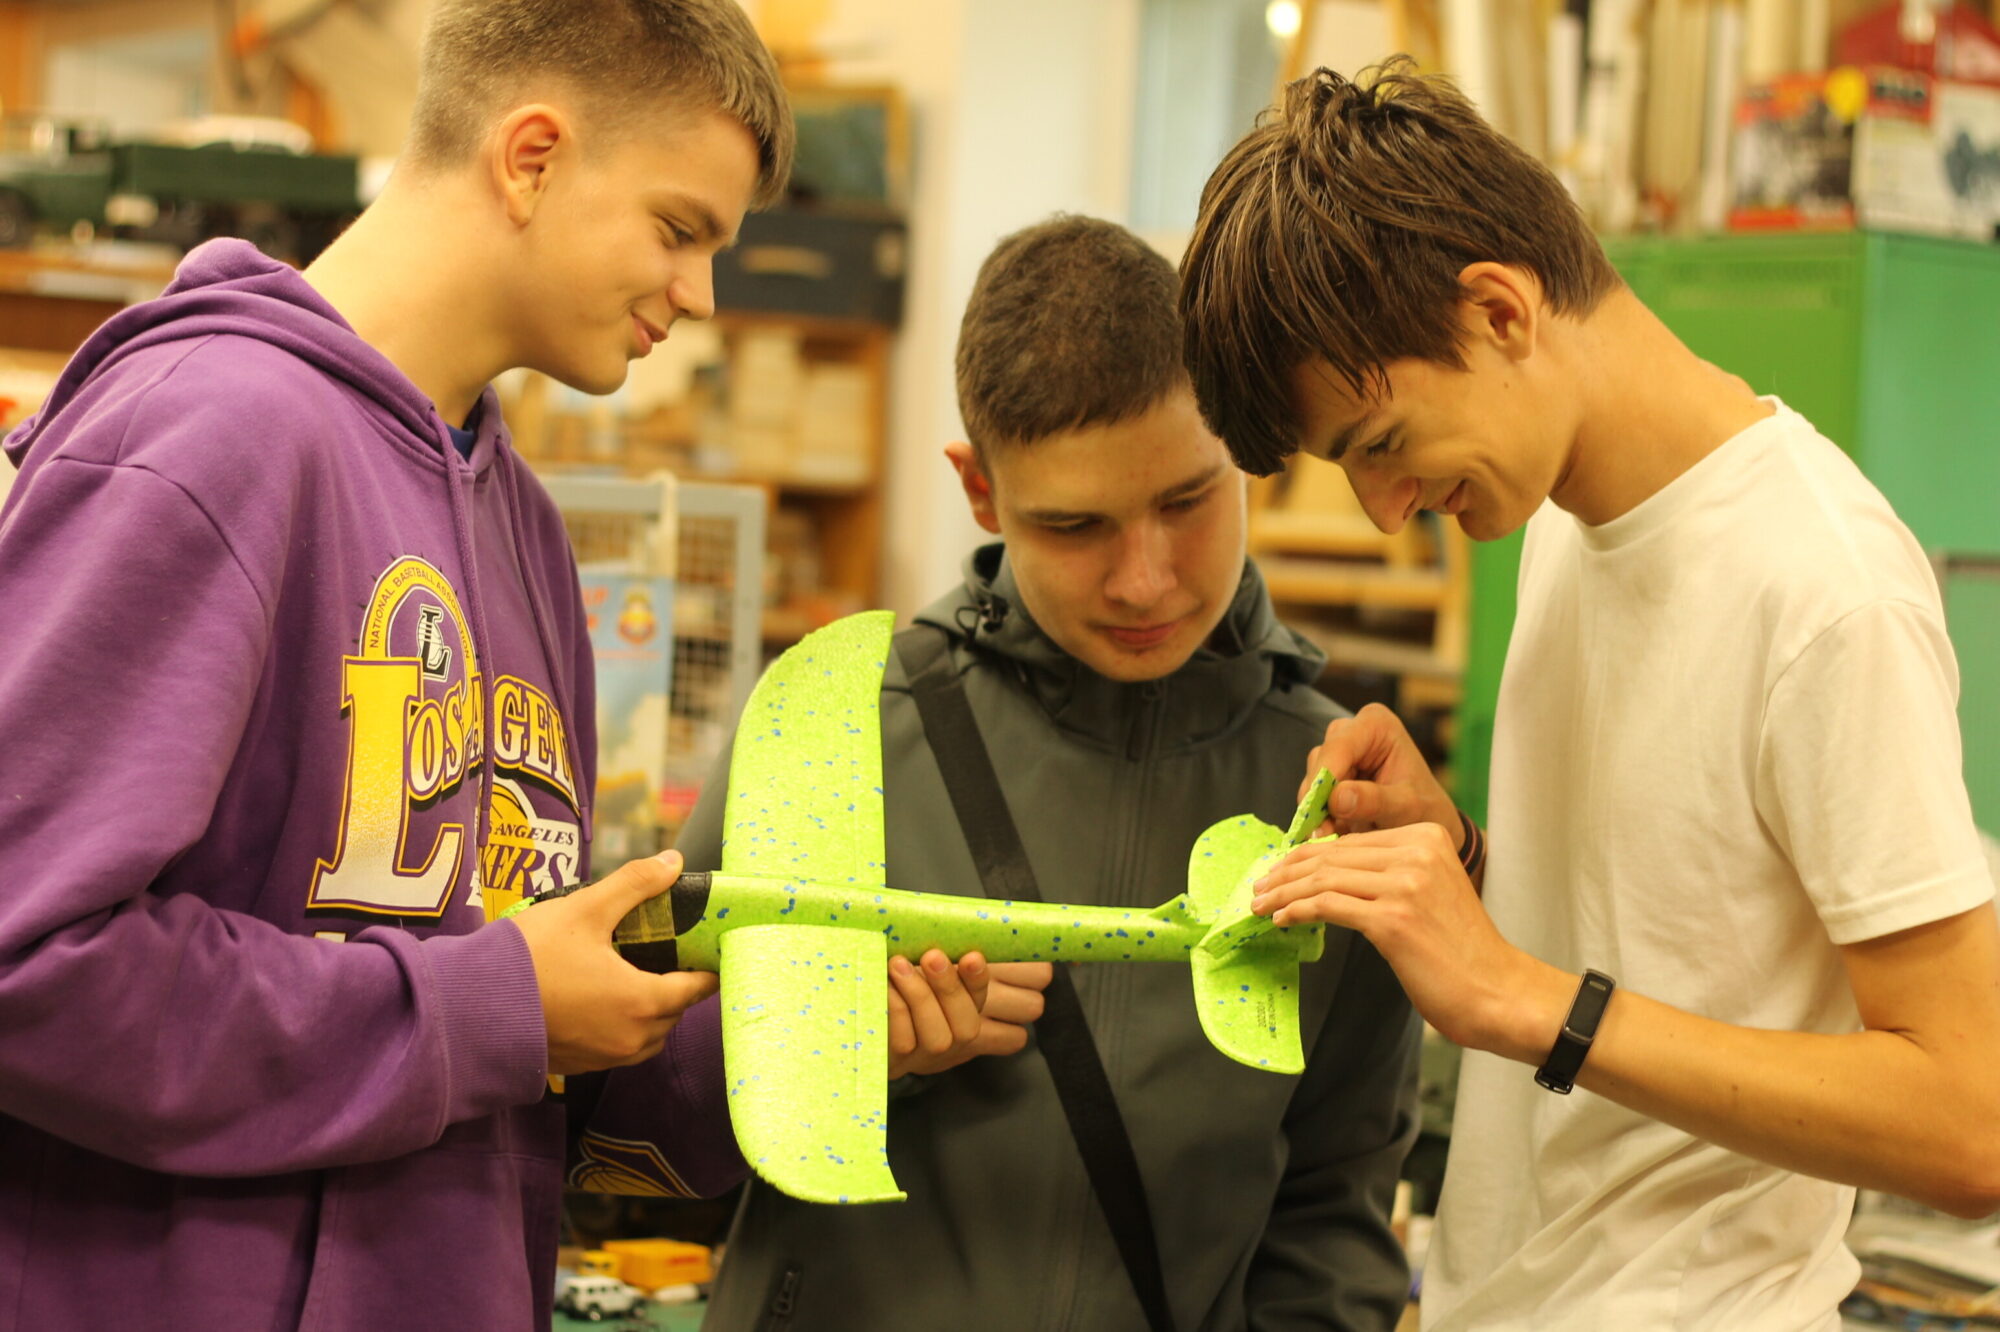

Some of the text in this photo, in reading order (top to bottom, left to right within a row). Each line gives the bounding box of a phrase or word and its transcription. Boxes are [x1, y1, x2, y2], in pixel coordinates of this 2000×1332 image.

[369, 588, 396, 648] NATIONAL
[494, 823, 575, 846] ANGELES
[480, 843, 573, 898] KERS
